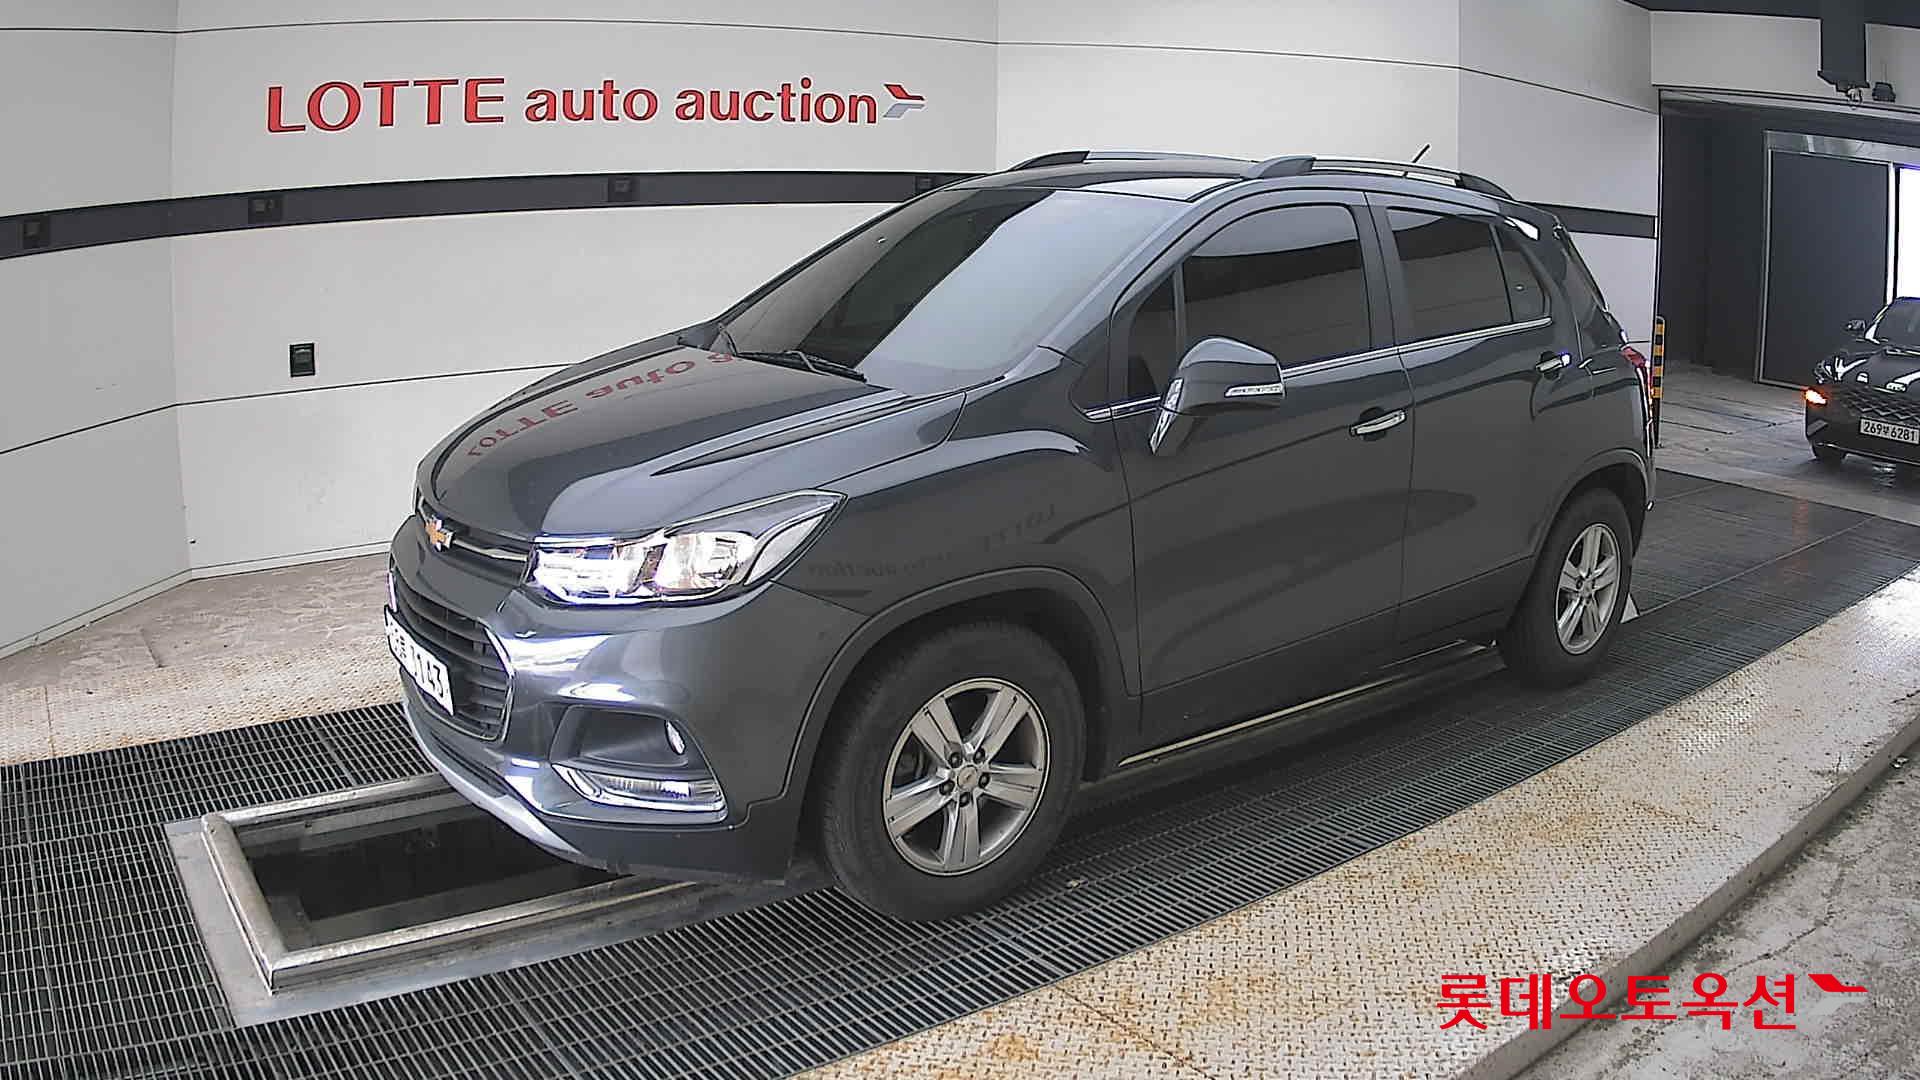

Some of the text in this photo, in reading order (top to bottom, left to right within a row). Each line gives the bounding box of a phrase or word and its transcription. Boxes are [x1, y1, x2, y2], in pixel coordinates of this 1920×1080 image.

[267, 77, 878, 133] LOTTE auto auction
